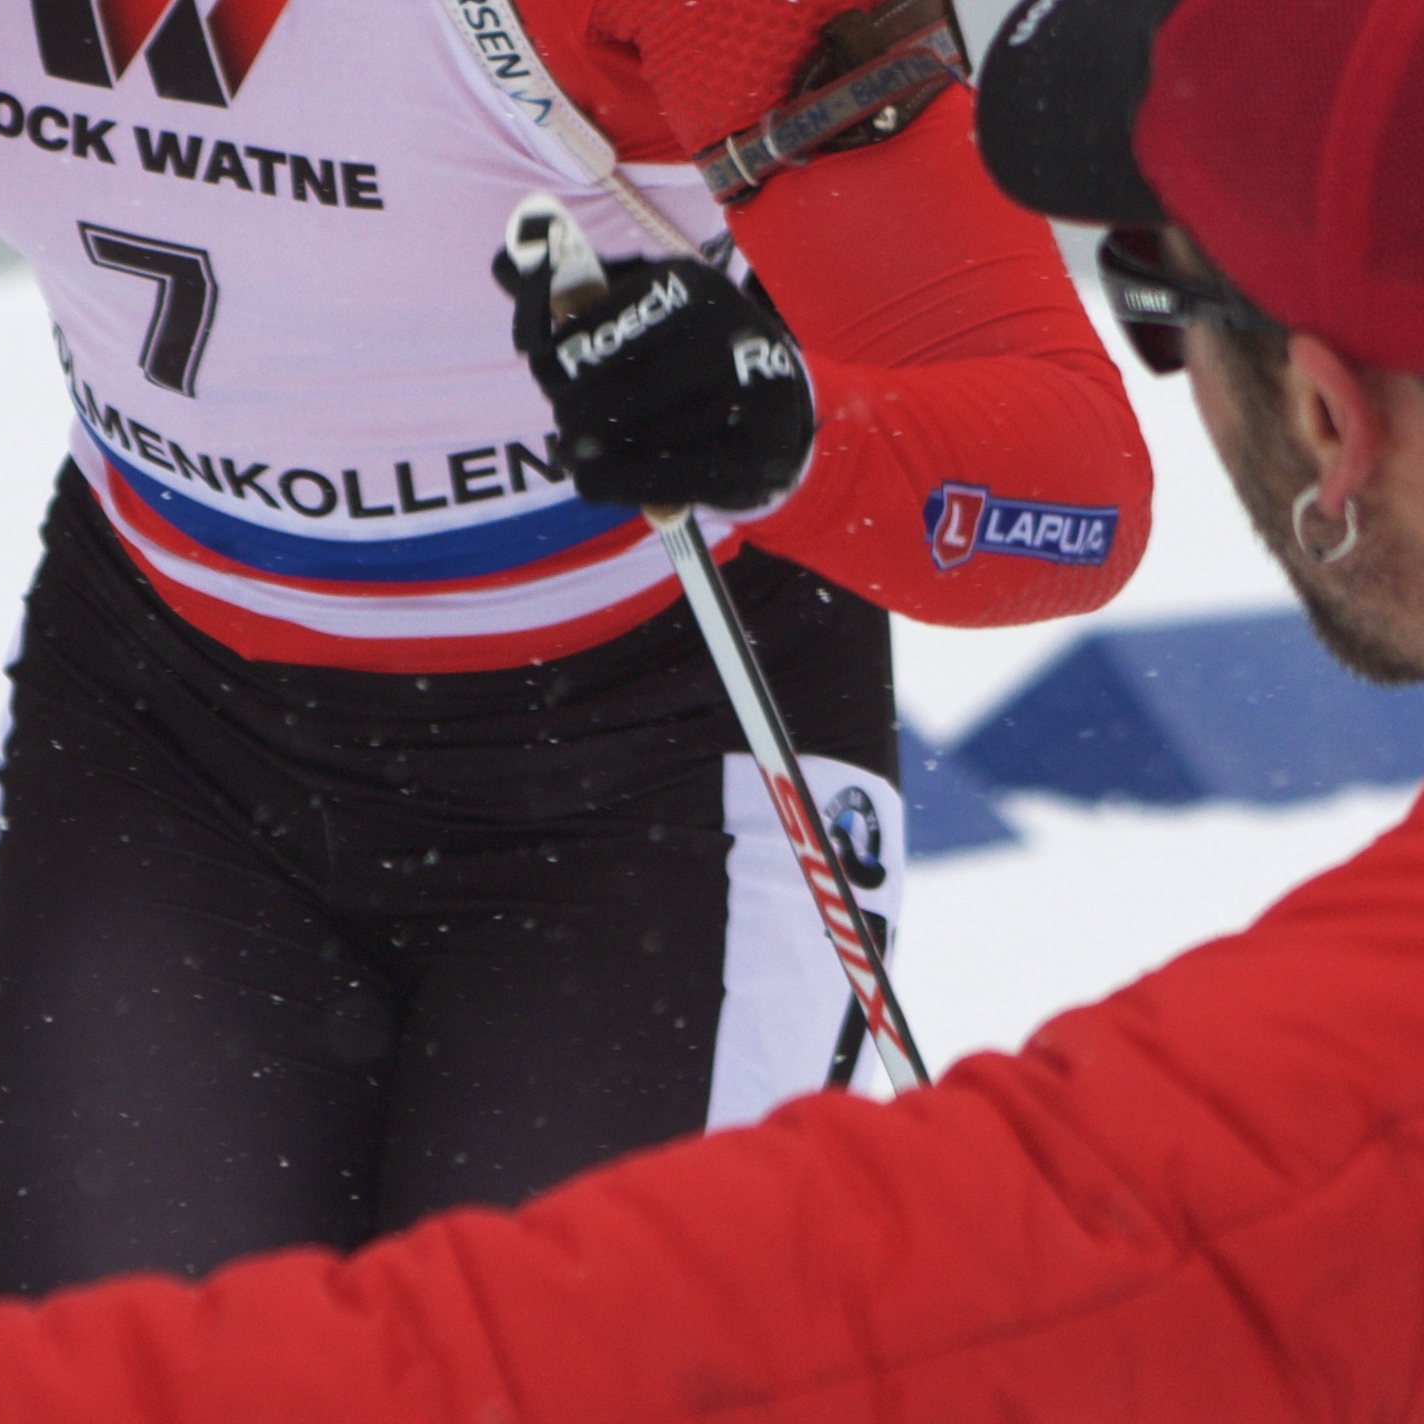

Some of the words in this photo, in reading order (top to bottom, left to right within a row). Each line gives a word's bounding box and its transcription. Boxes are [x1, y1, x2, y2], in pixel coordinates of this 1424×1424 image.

[132, 124, 385, 211] WATNE
[76, 219, 219, 399] 7
[983, 513, 1105, 558] LAPUA
